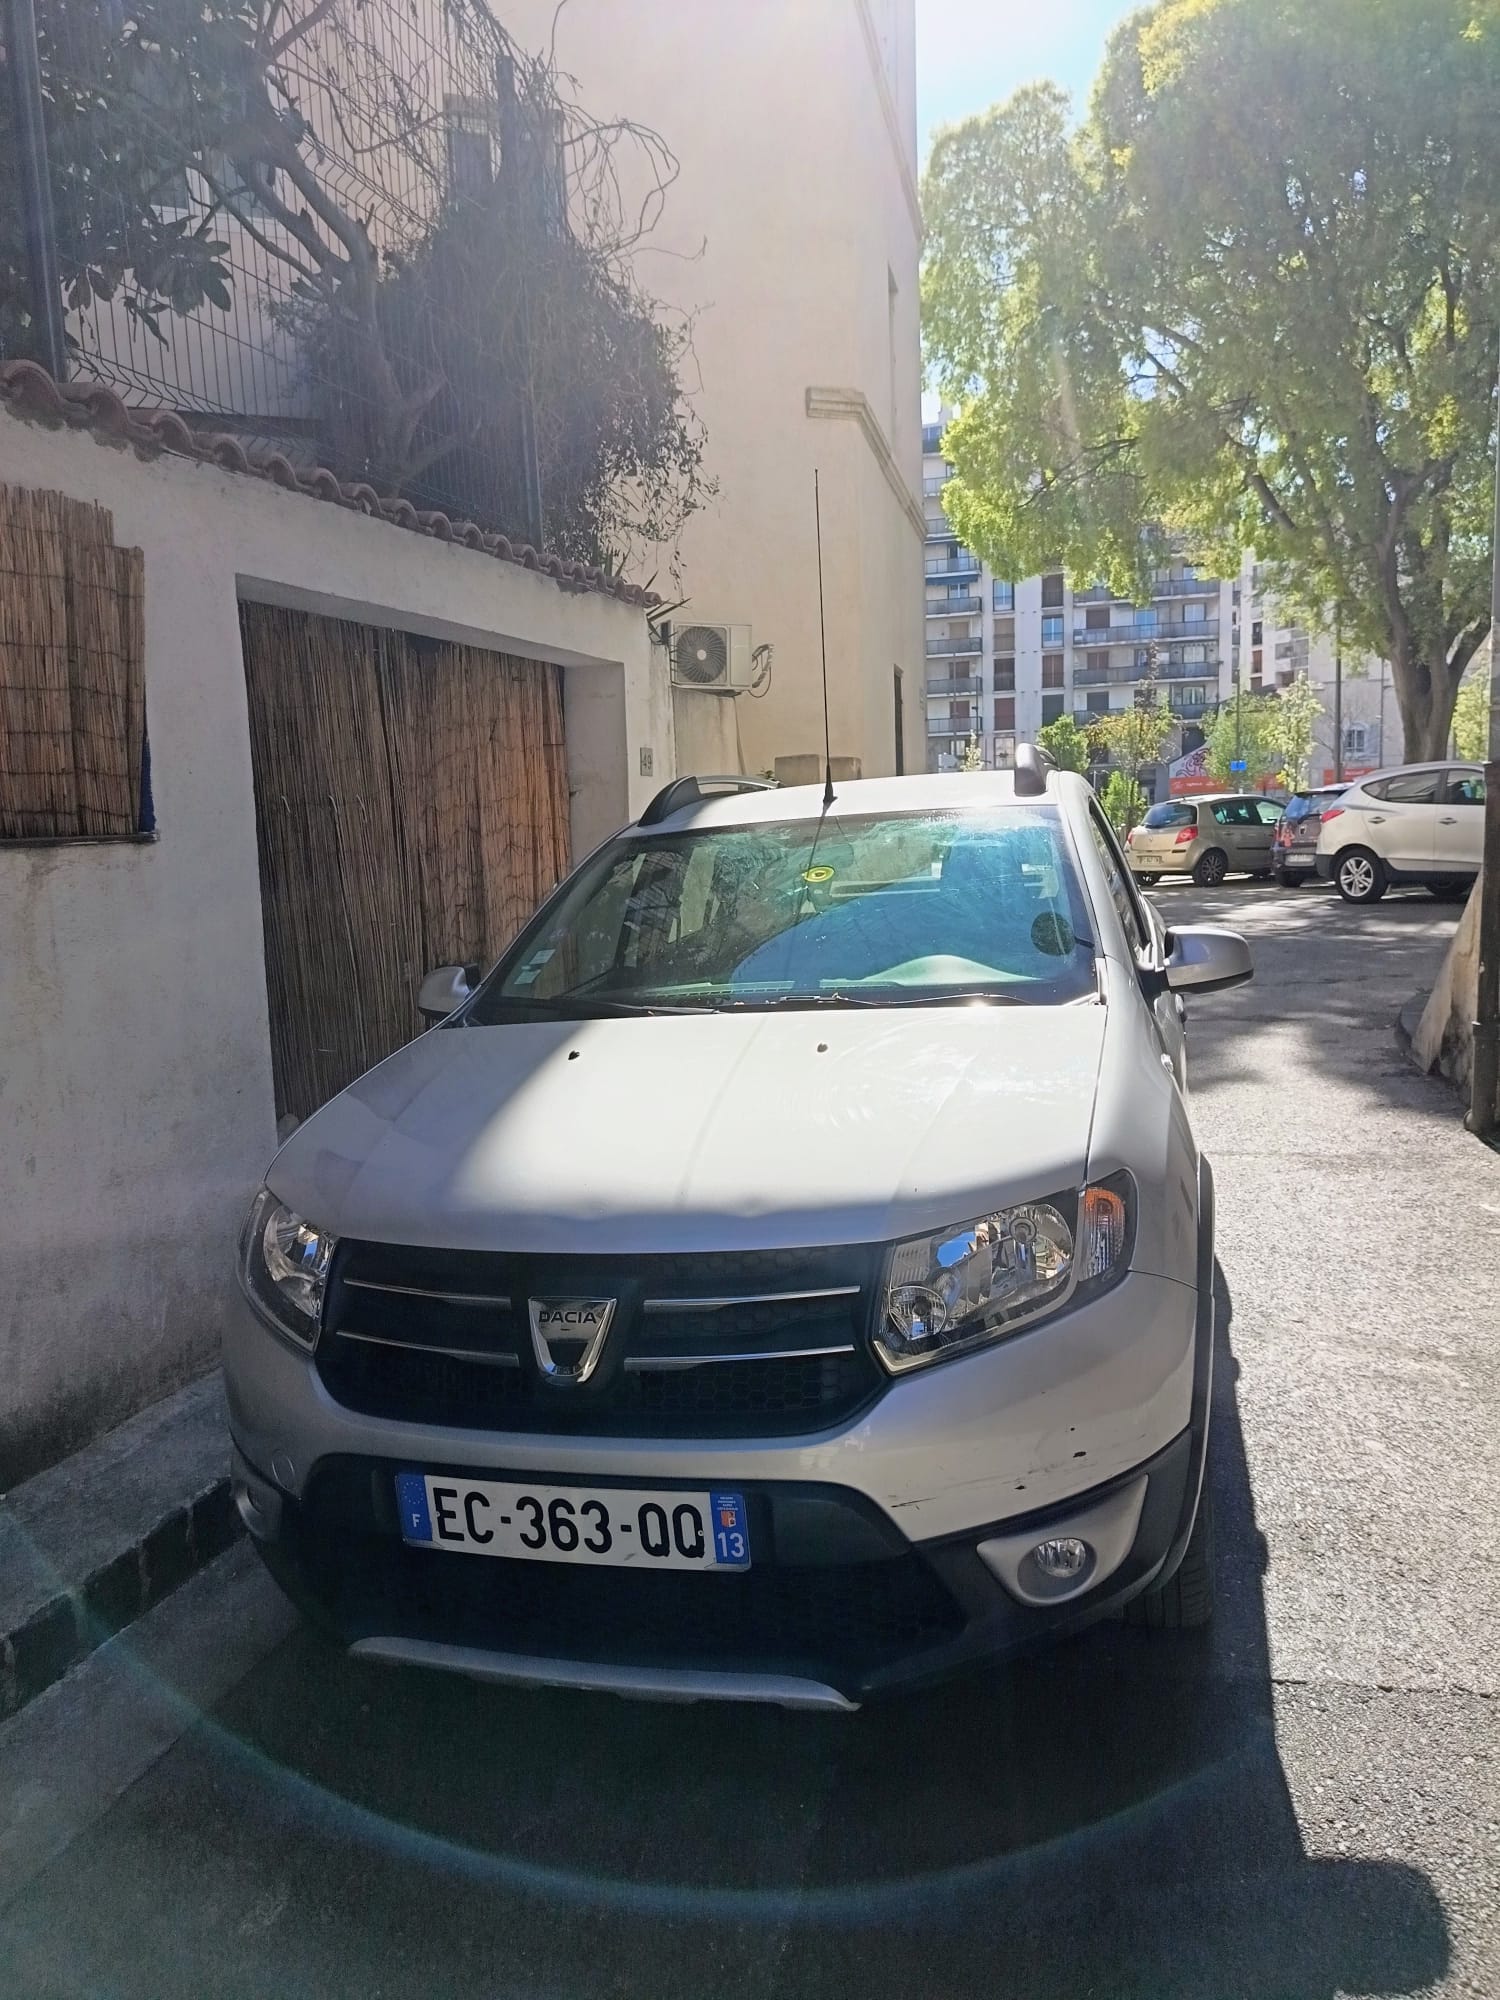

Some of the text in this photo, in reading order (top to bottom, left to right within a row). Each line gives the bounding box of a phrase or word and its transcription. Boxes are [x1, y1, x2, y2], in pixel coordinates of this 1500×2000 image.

[539, 1310, 597, 1324] DACIA
[412, 1513, 421, 1528] F
[432, 1486, 706, 1559] EC-363-QQ
[717, 1532, 745, 1558] 13
